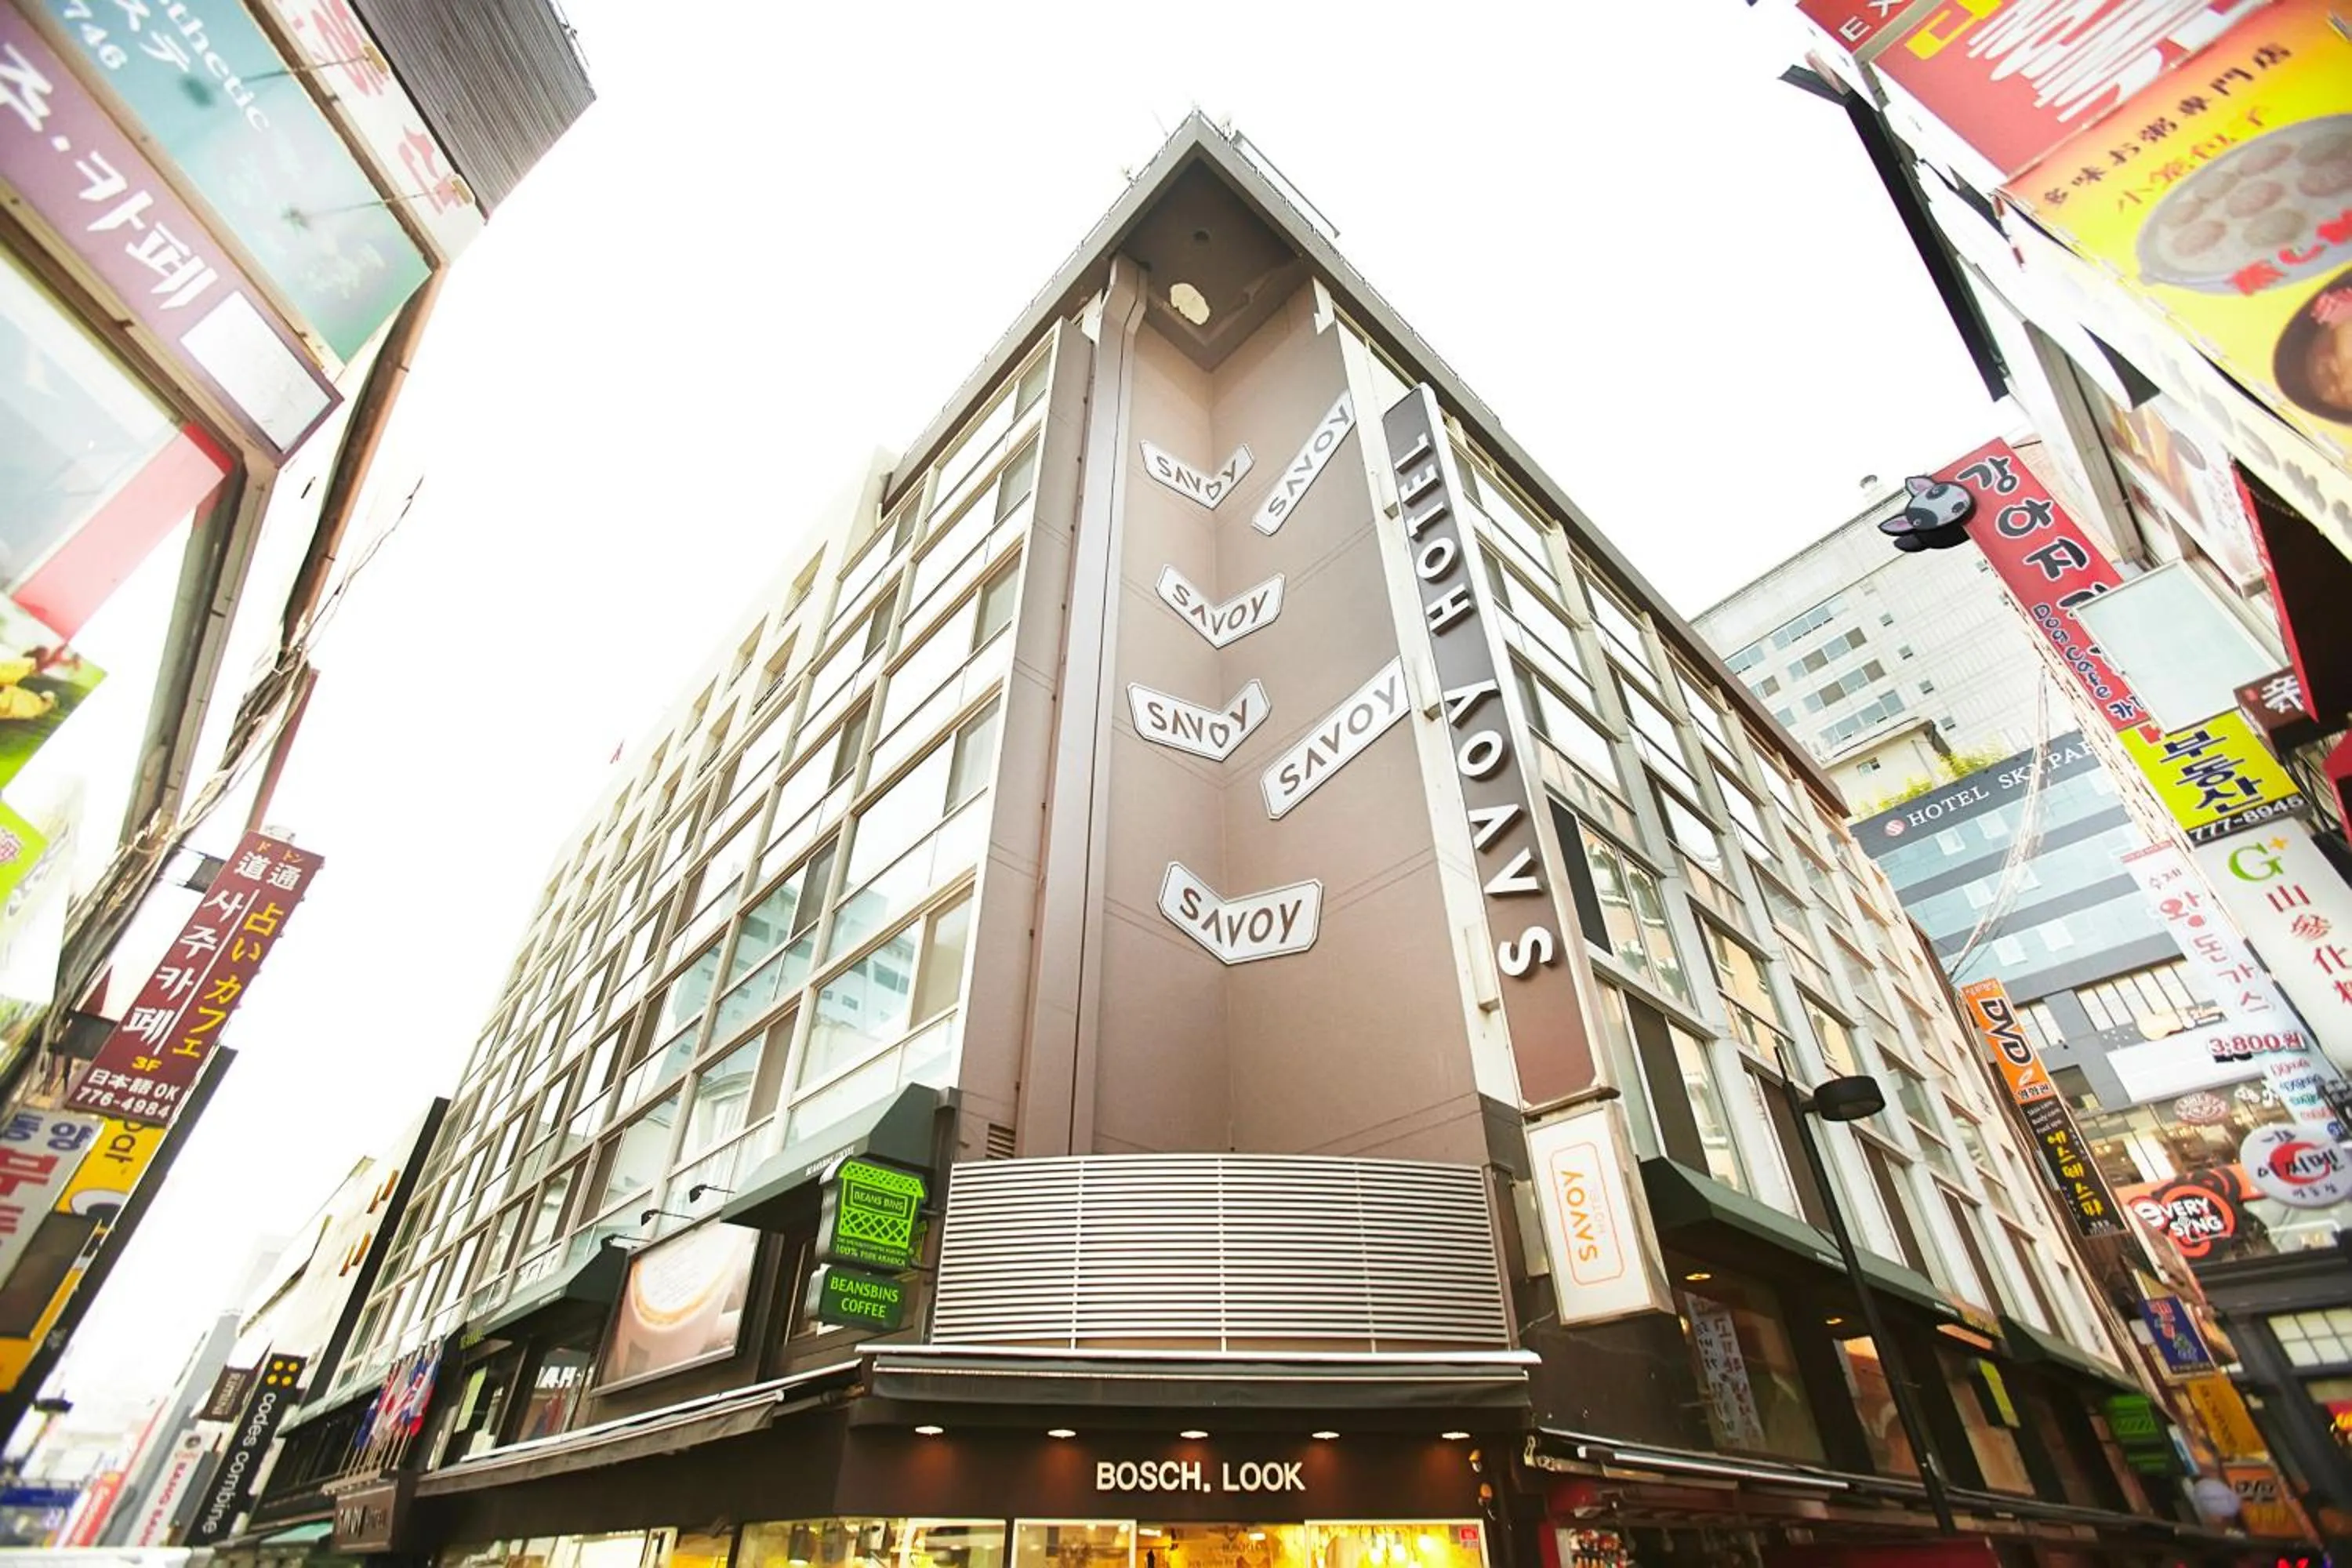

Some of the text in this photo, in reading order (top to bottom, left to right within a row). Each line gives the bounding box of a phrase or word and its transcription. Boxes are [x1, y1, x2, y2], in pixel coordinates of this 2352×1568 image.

[162, 0, 271, 133] thetic
[1156, 455, 1236, 501] SAVOY
[1268, 402, 1351, 517] SAVOY
[1173, 583, 1269, 635] SAVOY
[1147, 698, 1247, 749] SAVOY
[1395, 433, 1554, 977] SAVOY HOTEL
[1278, 676, 1396, 796] SAVOY
[2160, 730, 2263, 814] 부동산
[1906, 786, 1991, 828] HOTEL
[1179, 887, 1301, 947] SAVOY
[122, 890, 243, 1045] 사주카페
[172, 902, 285, 1058] 占いカフェ
[1979, 997, 2033, 1067] DVD
[132, 1056, 163, 1071] 3F
[76, 1086, 172, 1119] 776-4984
[1561, 1171, 1598, 1262] SAVOY
[830, 1276, 898, 1302] BEANSBINS
[841, 1298, 887, 1318] COFFEE
[242, 1392, 276, 1447] codes
[201, 1450, 250, 1534] combine
[1222, 1461, 1306, 1491] LOOK
